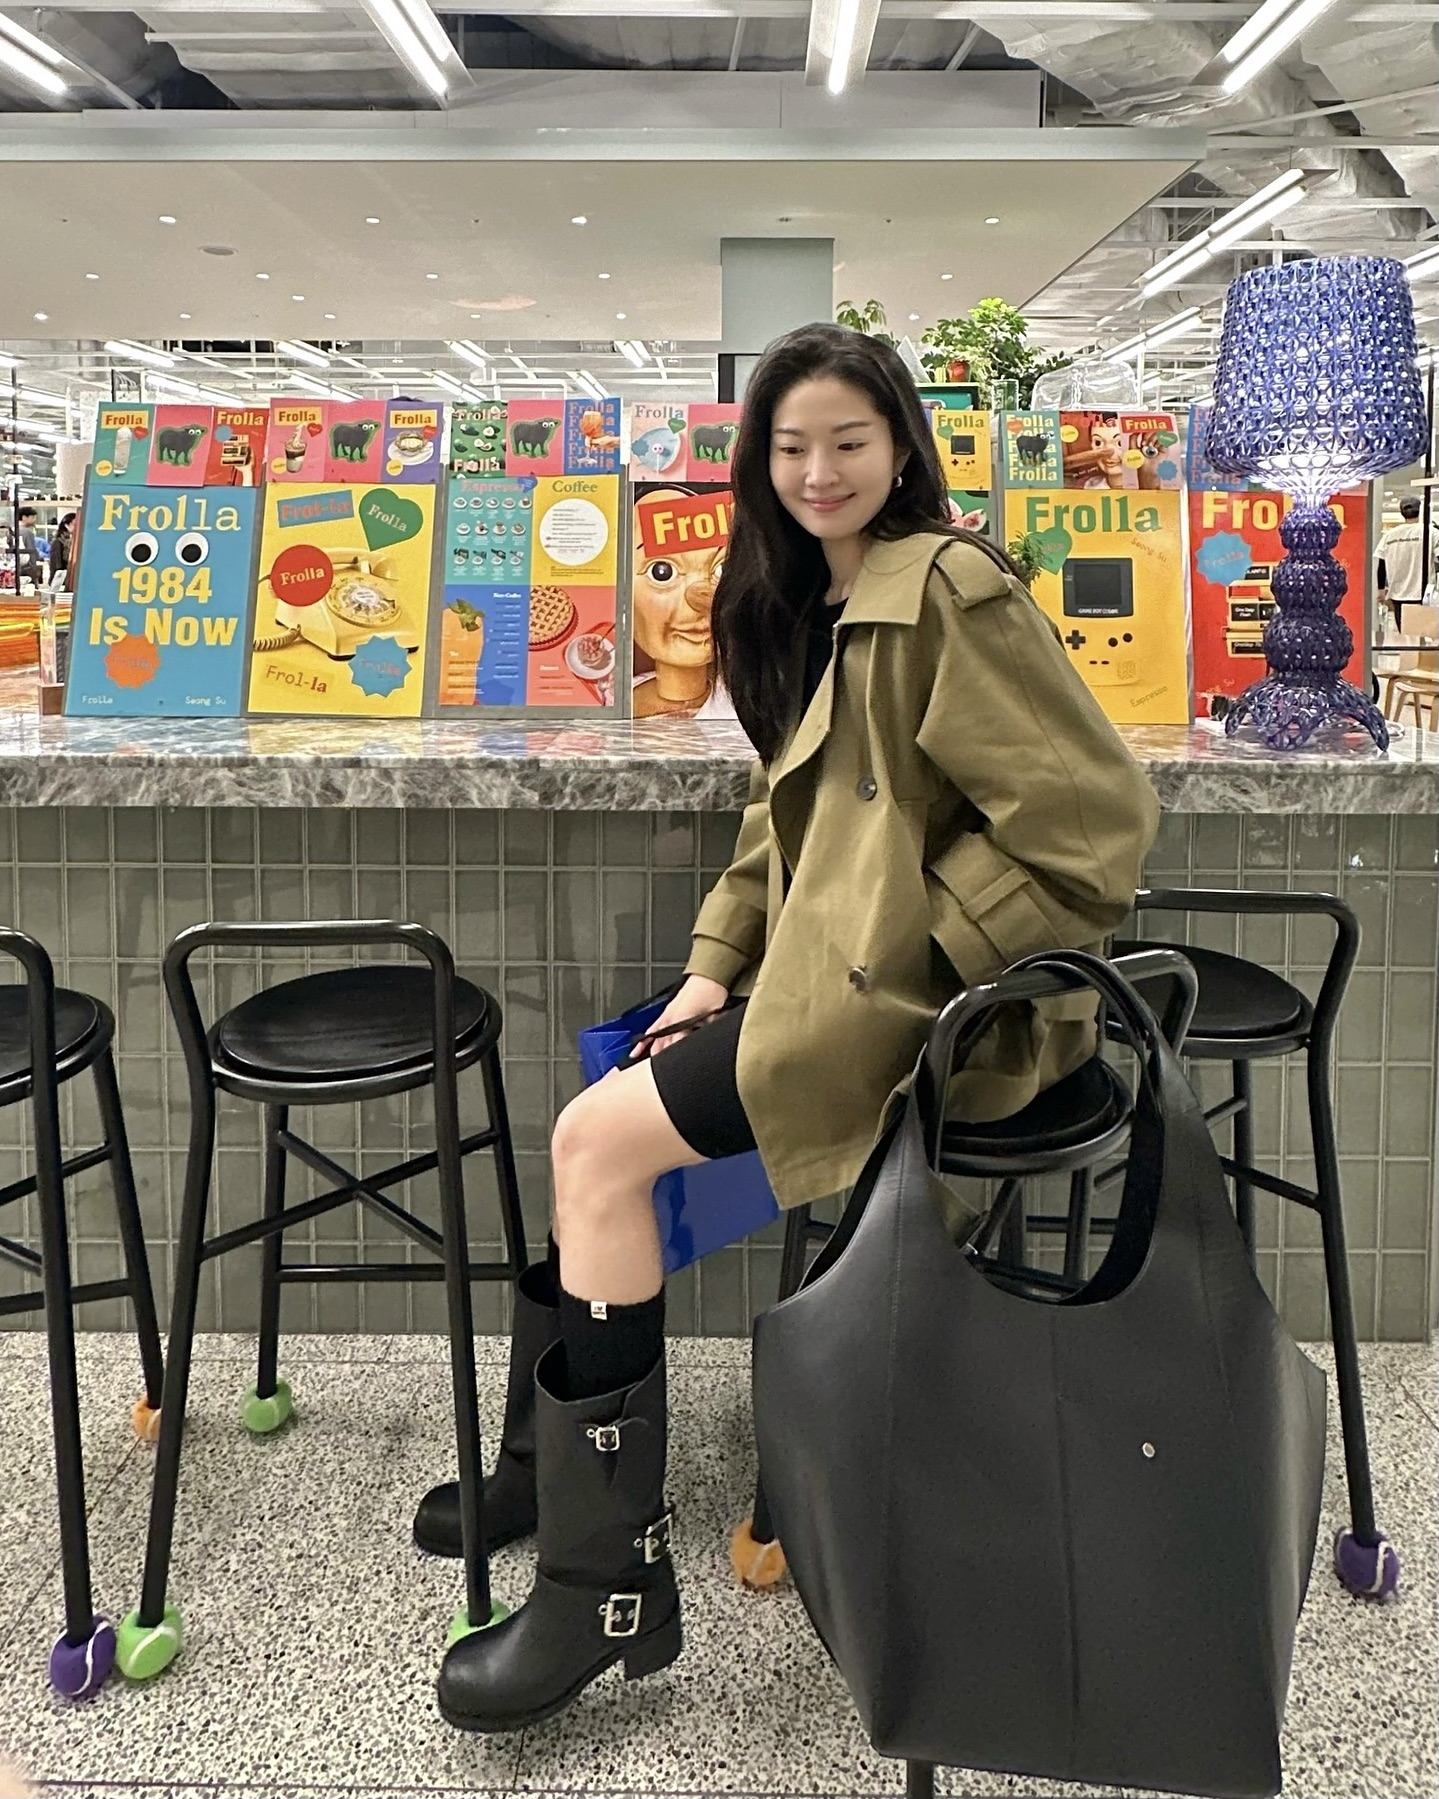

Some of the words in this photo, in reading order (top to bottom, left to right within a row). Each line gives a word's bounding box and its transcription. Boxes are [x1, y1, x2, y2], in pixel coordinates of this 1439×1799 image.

[217, 410, 264, 426] Frolla
[279, 411, 317, 422] Frolla
[634, 404, 684, 419] Frolla
[105, 414, 143, 426] Frolla
[394, 414, 432, 425] Frolla
[937, 414, 984, 428] Frolla
[1126, 419, 1167, 430] Frolla
[1009, 467, 1058, 481] Frolla
[552, 480, 599, 493] Coffee
[97, 494, 242, 531] Frolla
[367, 503, 409, 532] Frolla
[1026, 495, 1163, 533] Frolla
[280, 567, 326, 586] Frolla
[112, 566, 213, 605] 1984
[89, 607, 129, 646] Is
[144, 607, 239, 647] Now
[265, 664, 328, 693] Frol-la
[82, 695, 113, 704] Frolla
[1130, 685, 1168, 708] Espresso
